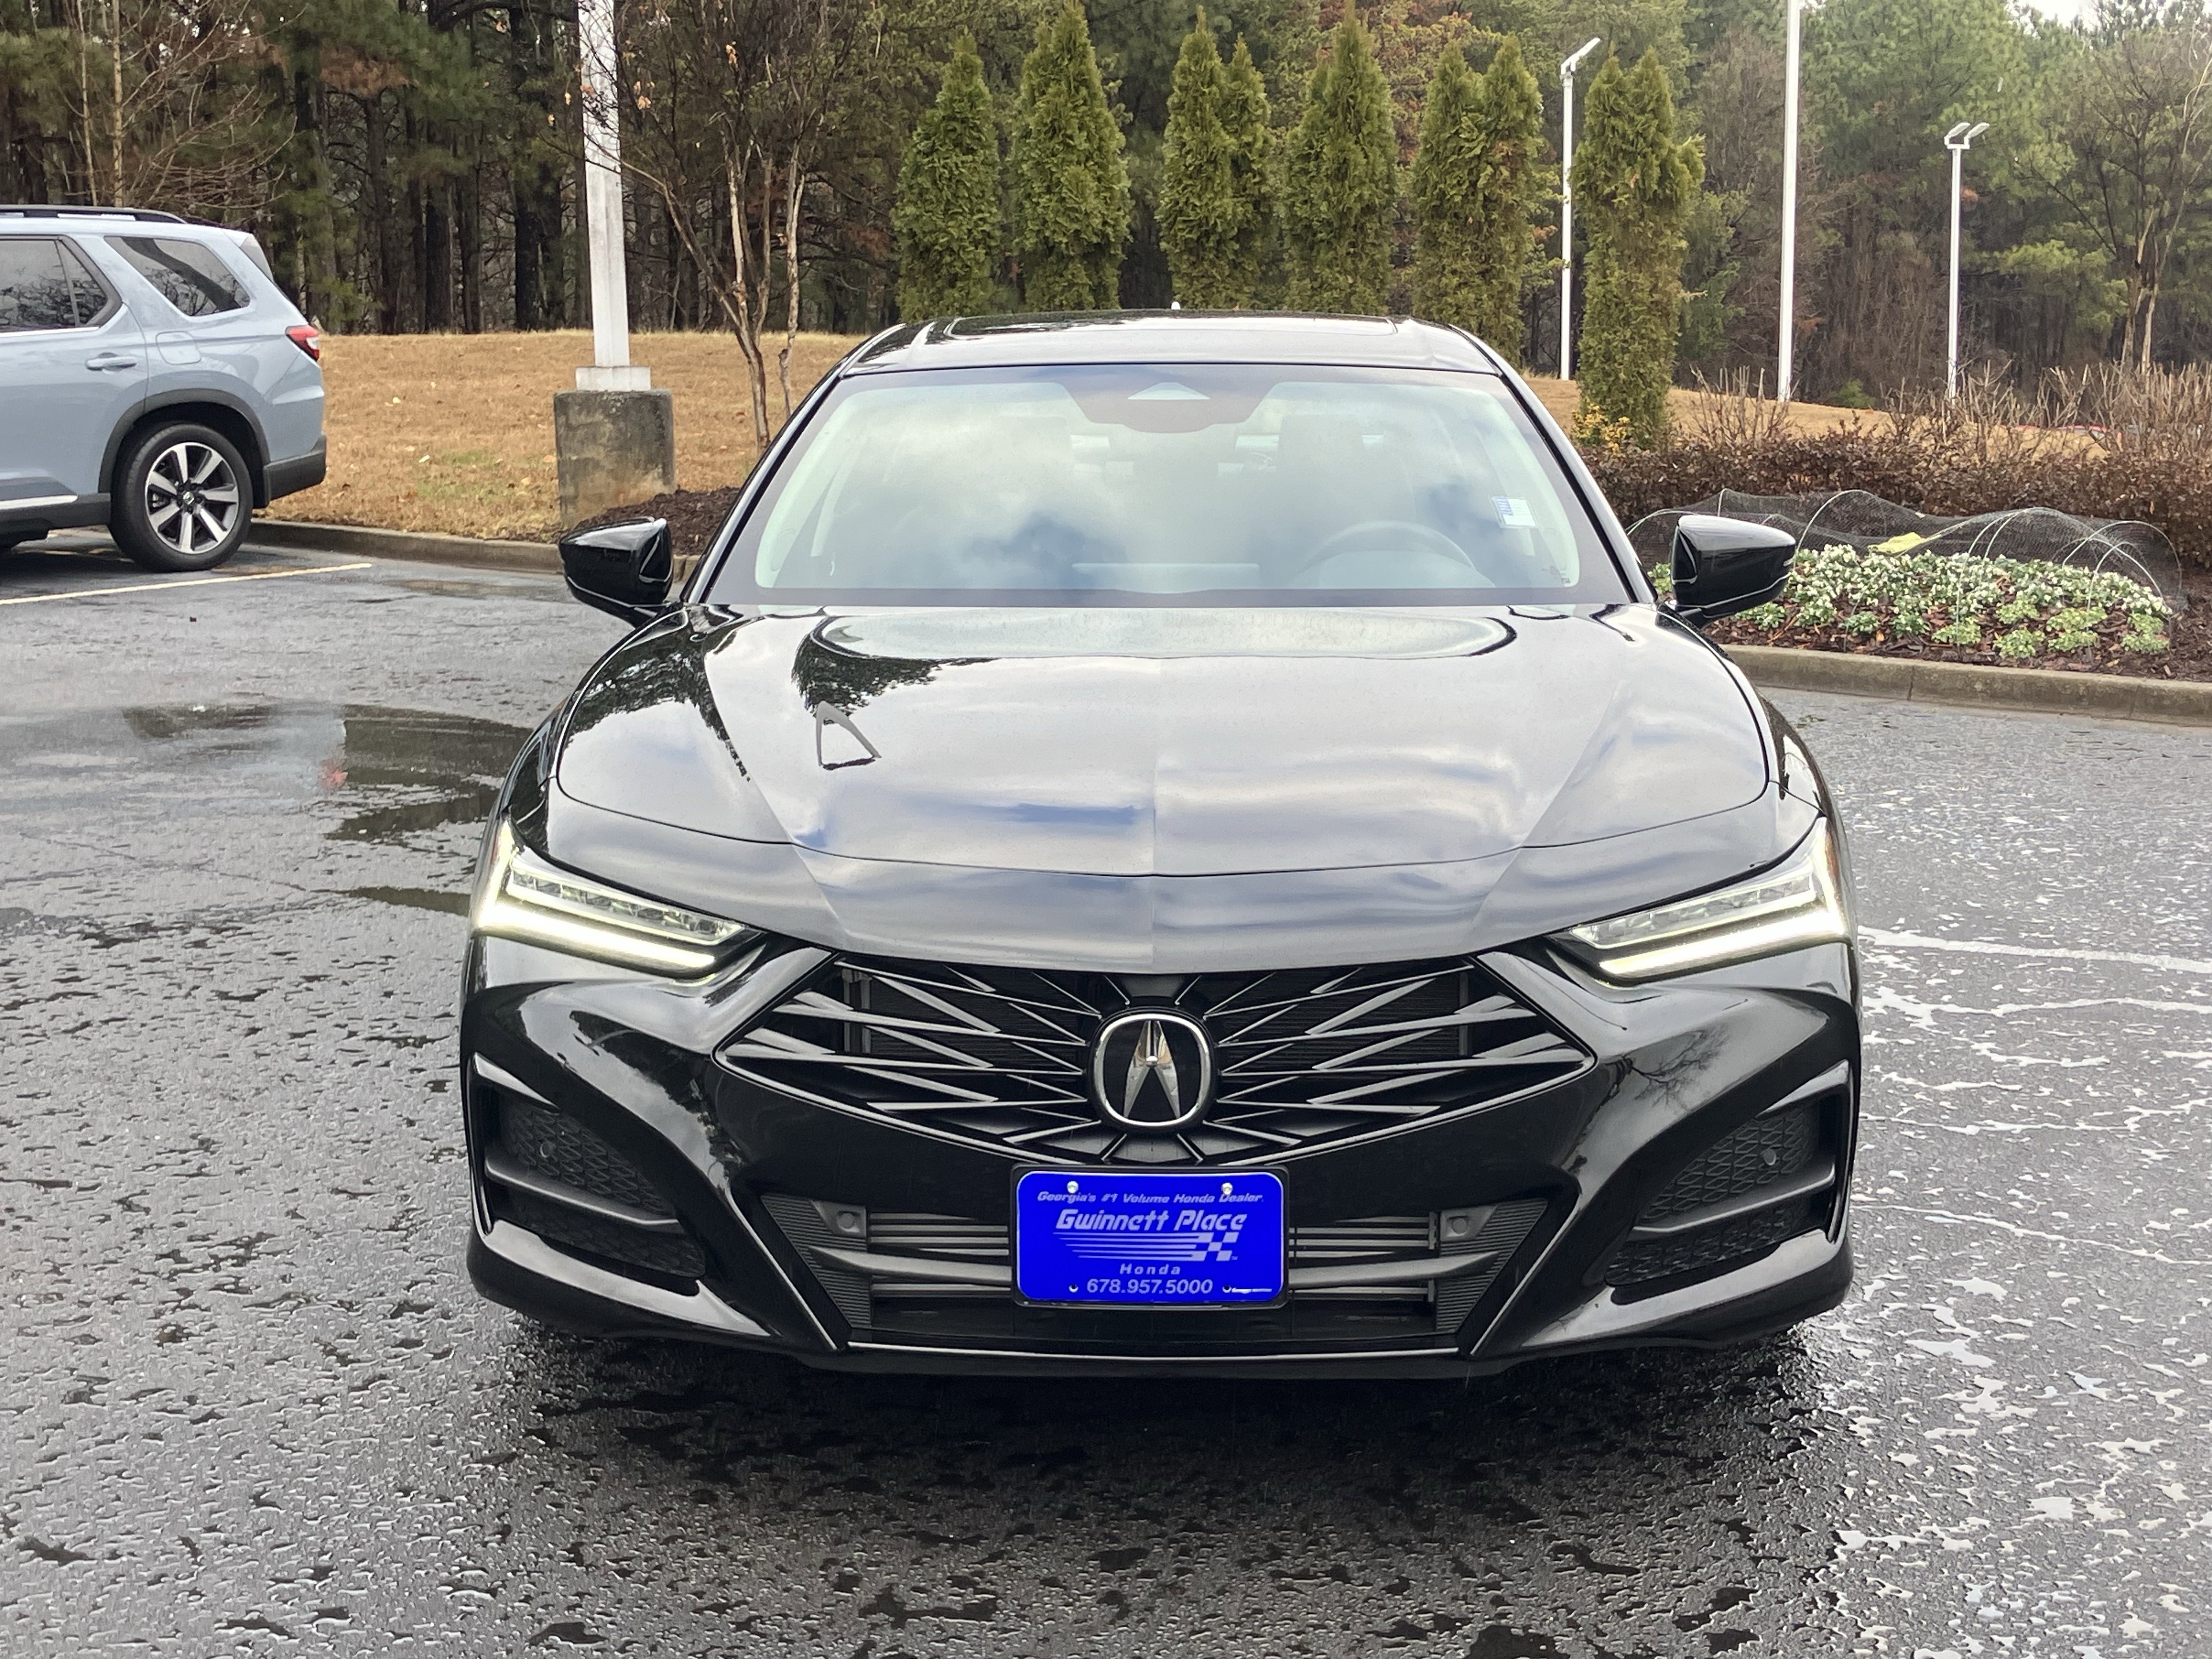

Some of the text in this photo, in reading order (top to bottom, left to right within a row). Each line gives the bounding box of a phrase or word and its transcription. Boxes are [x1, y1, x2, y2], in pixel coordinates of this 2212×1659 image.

[1037, 1191, 1096, 1204] Georgia's
[1101, 1193, 1118, 1203] #1
[1123, 1193, 1170, 1203] Volume
[1173, 1194, 1215, 1203] Honda
[1056, 1209, 1248, 1231] Gwinnett Place
[1120, 1263, 1181, 1276] Honda
[1087, 1279, 1214, 1294] 678.957.5000
